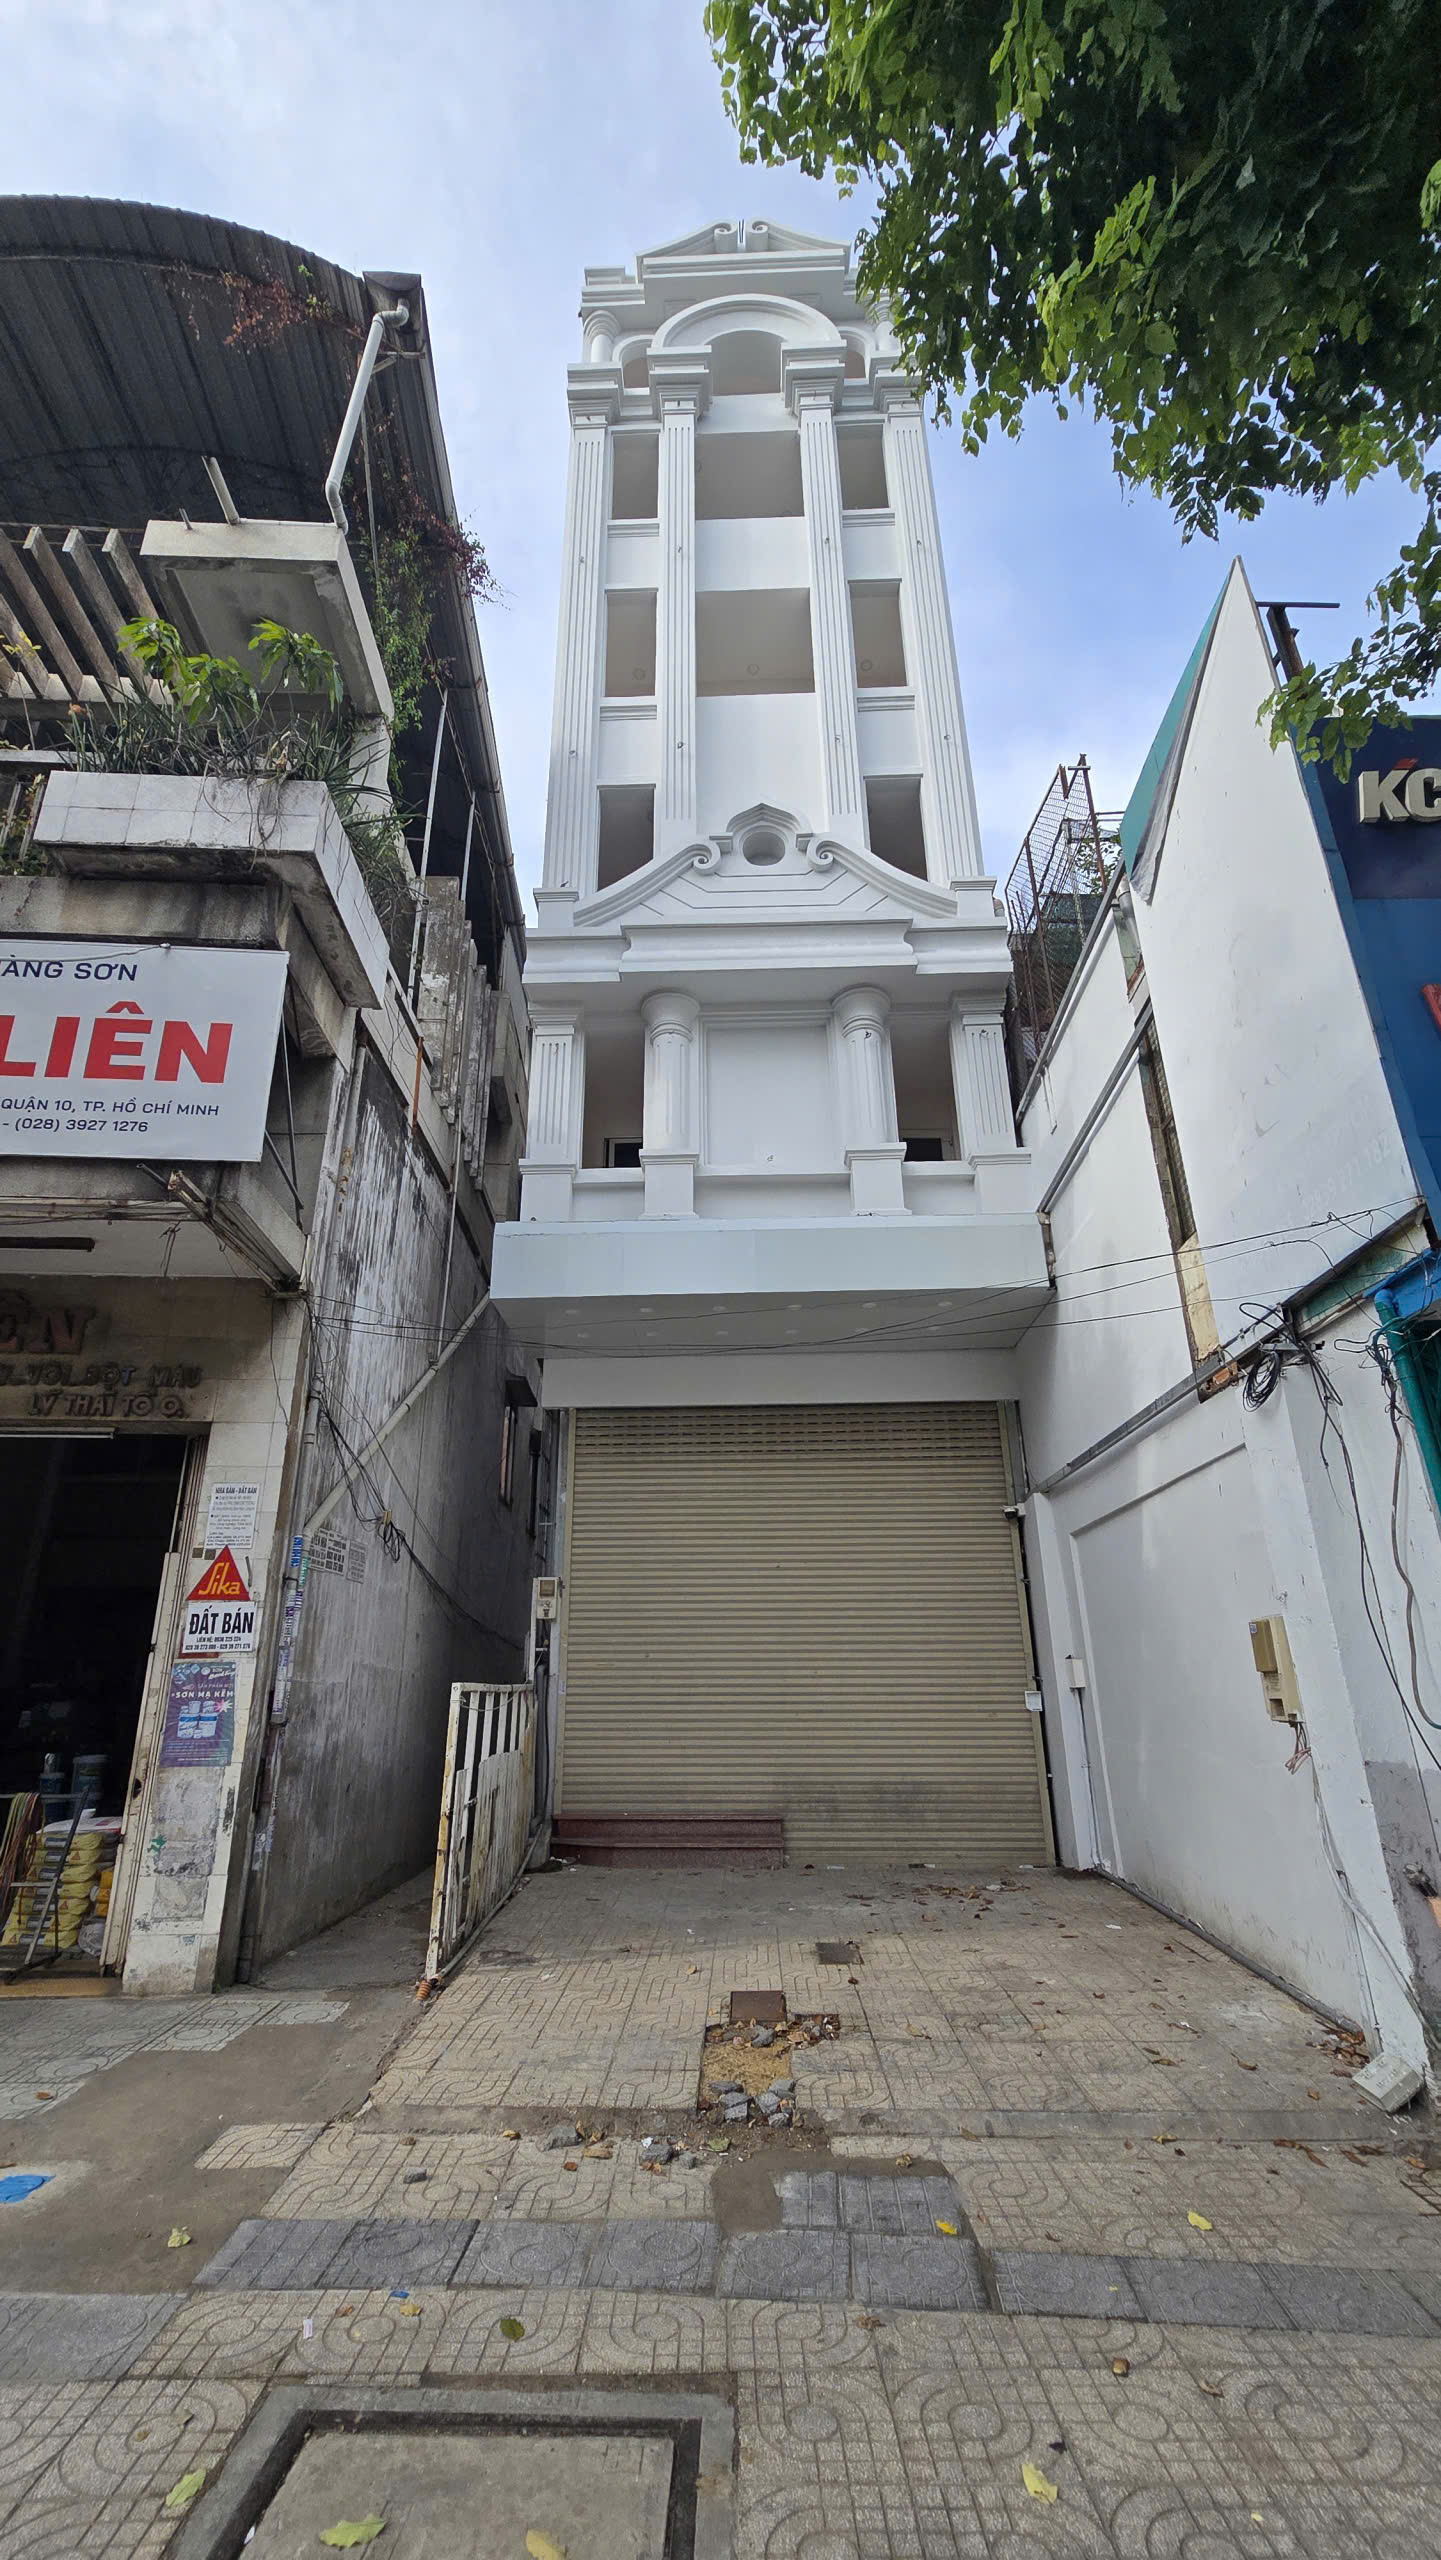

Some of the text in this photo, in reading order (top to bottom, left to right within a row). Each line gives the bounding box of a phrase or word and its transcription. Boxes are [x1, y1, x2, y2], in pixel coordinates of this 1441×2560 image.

[0, 954, 138, 981] ÀNG SƠN
[1, 1096, 219, 1116] QUẬN 10, TP. HỒ CHÍ MINH
[15, 1118, 60, 1132] (028)
[65, 1119, 107, 1131] 3927
[113, 1121, 149, 1132] 1276
[198, 1562, 241, 1595] Sika
[189, 1605, 254, 1634] ĐẤT BÁN
[175, 1690, 195, 1698] SƠN
